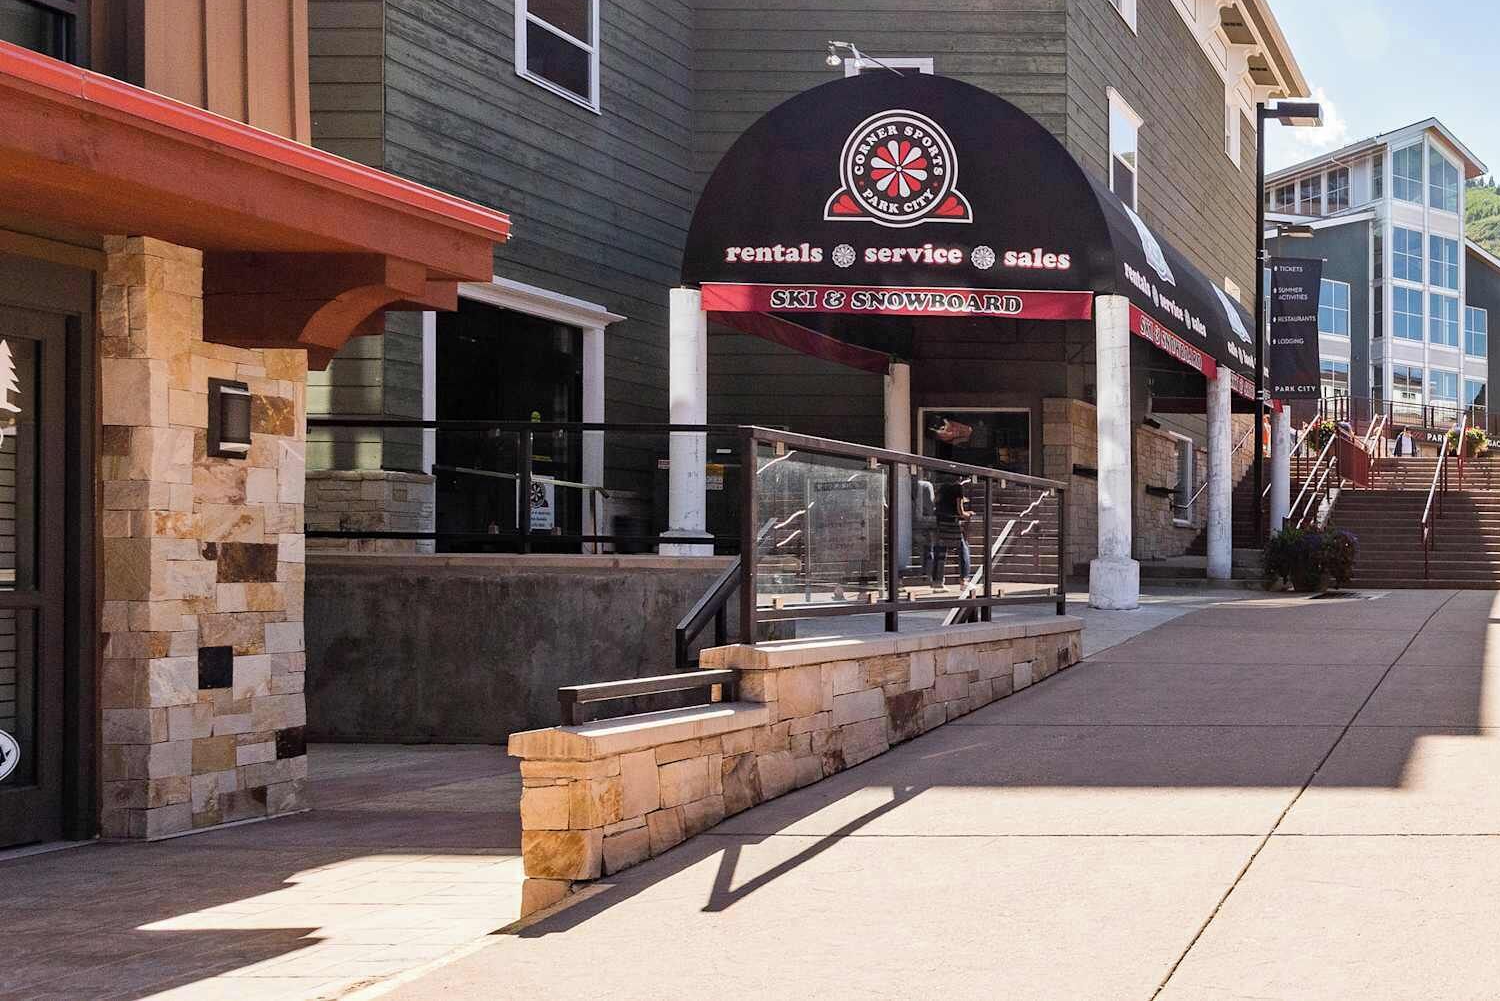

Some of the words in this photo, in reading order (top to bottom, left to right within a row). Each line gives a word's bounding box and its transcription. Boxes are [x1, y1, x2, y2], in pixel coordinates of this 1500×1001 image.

[854, 125, 899, 176] CORNER
[903, 126, 944, 177] SPORTS
[862, 187, 899, 214] PARK
[902, 188, 934, 213] CITY
[725, 243, 823, 264] rentals
[864, 244, 962, 265] service
[1004, 248, 1071, 271] sales
[1279, 265, 1303, 273] TICKETS
[1123, 262, 1151, 298] rentals
[770, 288, 818, 309] SKI
[822, 289, 845, 310] &
[850, 290, 1023, 315] SNOWBOARD
[1277, 315, 1316, 323] RESTAURANTS
[1277, 337, 1304, 345] LODGING
[1274, 385, 1296, 393] PARK
[1297, 385, 1317, 393] CITY
